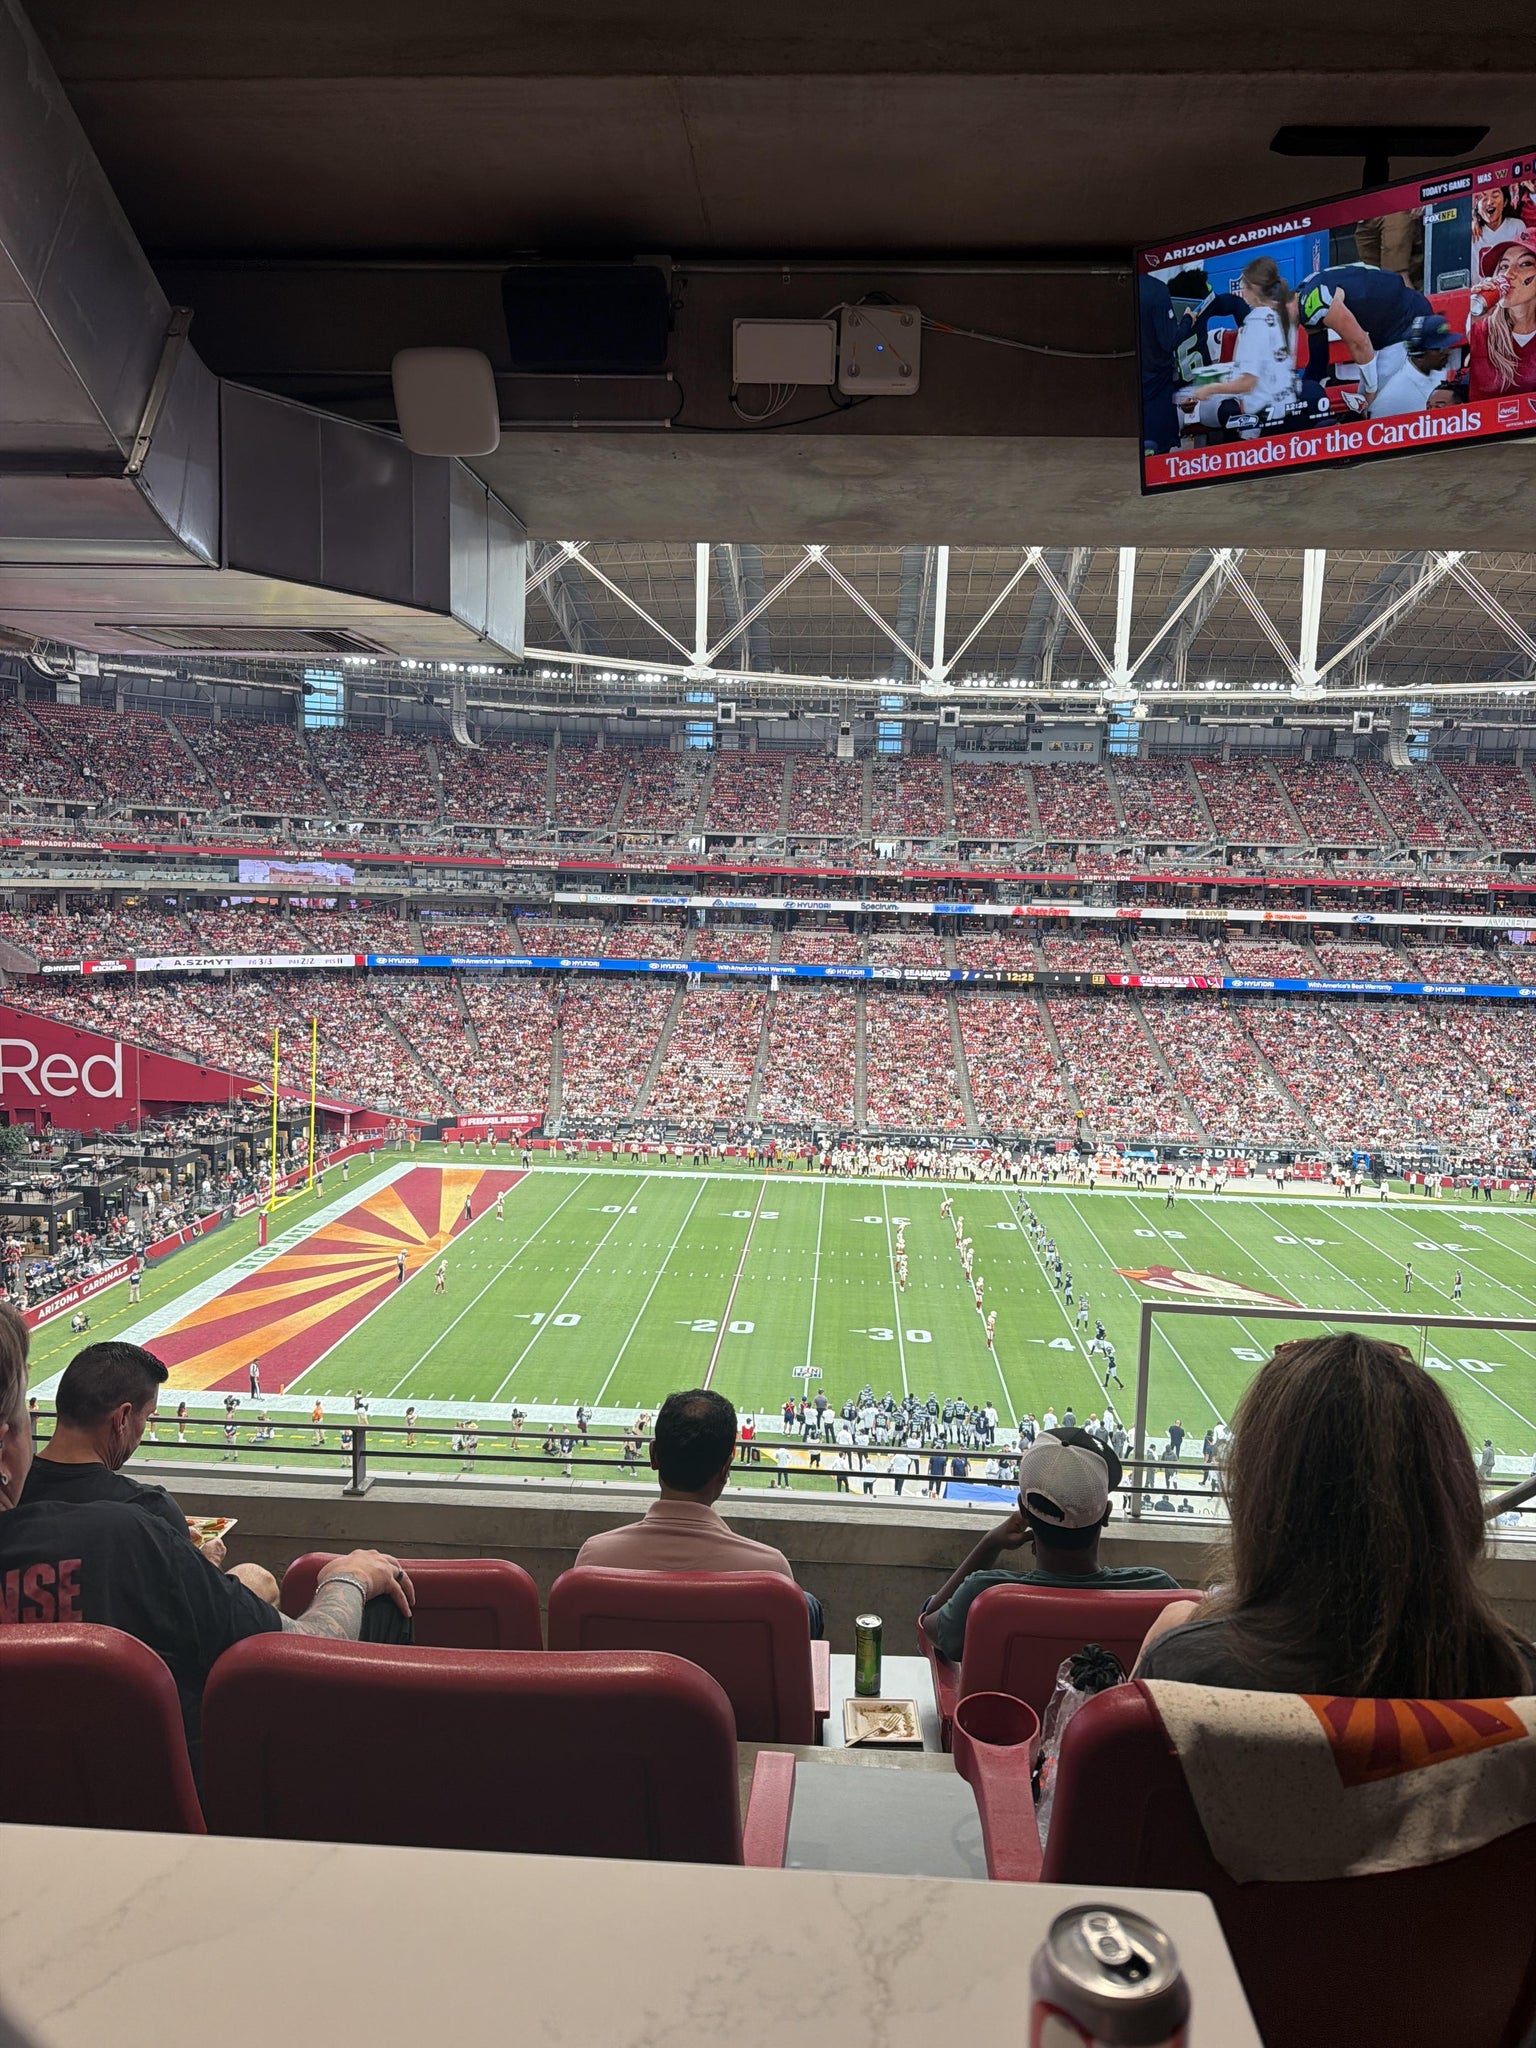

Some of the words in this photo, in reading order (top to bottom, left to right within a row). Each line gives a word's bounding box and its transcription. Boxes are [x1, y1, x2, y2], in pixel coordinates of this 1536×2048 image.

[1477, 173, 1492, 184] WAS
[1422, 184, 1448, 198] TODAY'S
[1448, 178, 1471, 191] GAMES
[1424, 213, 1440, 224] FOX
[1441, 209, 1456, 221] NFL
[1163, 239, 1226, 262] ARIZONA
[1228, 217, 1312, 246] CARDINALS
[1265, 406, 1276, 421] 7
[1317, 397, 1330, 412] 0
[1166, 452, 1222, 478] Taste
[1225, 441, 1286, 469] made
[1289, 436, 1322, 459] for
[1326, 429, 1362, 453] the
[1367, 408, 1482, 446] Cardinals
[71, 841, 104, 849] DRISCOLL
[797, 901, 832, 909] HYUNDAI
[860, 902, 898, 911] Spectrum
[1026, 907, 1048, 916] State
[1049, 908, 1070, 917] Farm
[174, 958, 233, 967] A.SZMYT
[258, 957, 273, 966] 3/3
[301, 957, 315, 965] 2/2
[904, 969, 951, 977] SEAHAWKS
[962, 971, 969, 980] 7
[1006, 972, 1035, 981] 12:25
[1121, 976, 1129, 984] 0
[1140, 975, 1189, 984] CARDINALS
[0, 1038, 123, 1098] Red
[467, 1116, 529, 1126] RIVALRIES
[233, 1247, 282, 1269] STOP
[274, 1224, 321, 1244] HATE
[38, 1290, 79, 1321] ARIZONA
[82, 1264, 128, 1295] CARDINALS
[530, 1312, 582, 1327] 10
[690, 1319, 755, 1334] 20
[868, 1327, 932, 1344] 30
[1230, 1347, 1265, 1362] 5
[1423, 1357, 1494, 1373] 40
